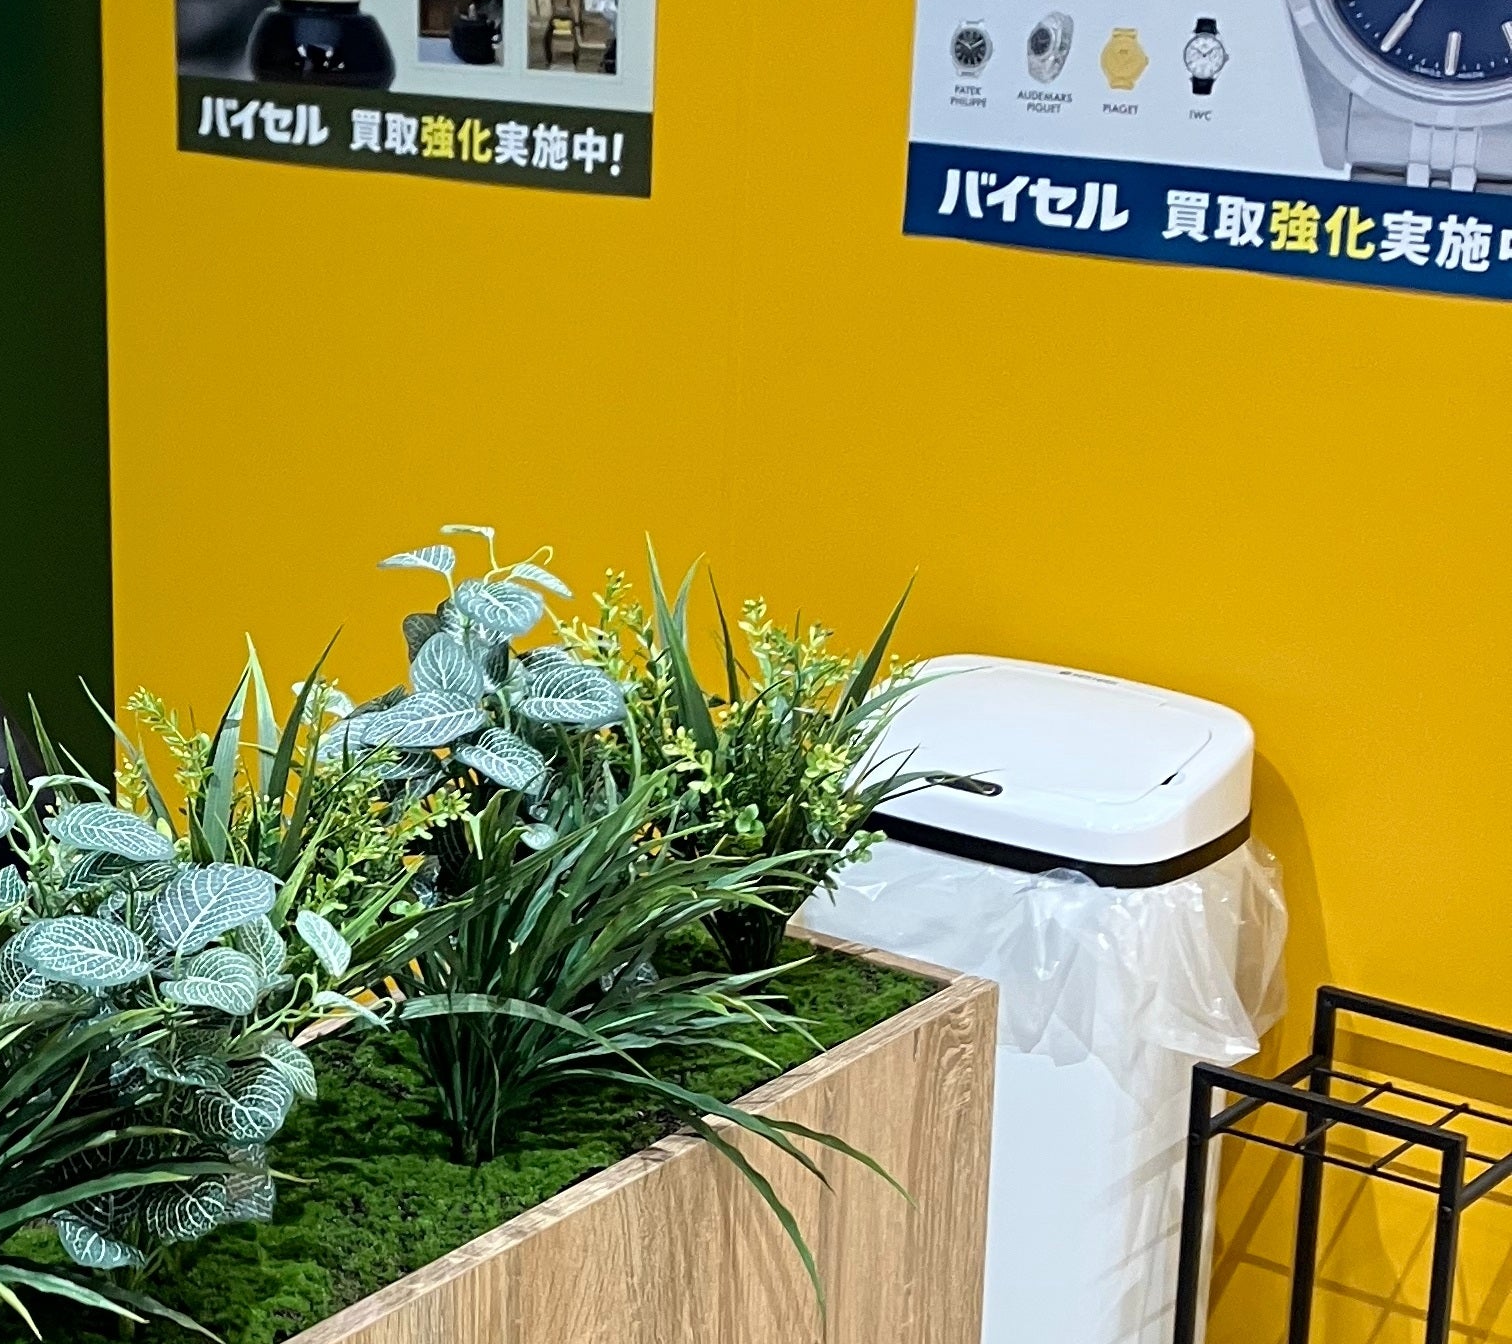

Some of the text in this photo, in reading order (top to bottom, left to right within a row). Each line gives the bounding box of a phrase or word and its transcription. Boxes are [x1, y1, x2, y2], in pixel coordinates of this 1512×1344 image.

[1017, 90, 1072, 103] AUDEMARS
[1103, 104, 1138, 115] PIAGET
[1189, 110, 1212, 121] IWC
[198, 95, 625, 177] バイセル 買取強化実施中!
[938, 169, 1512, 273] バイセル 買取強化実施
